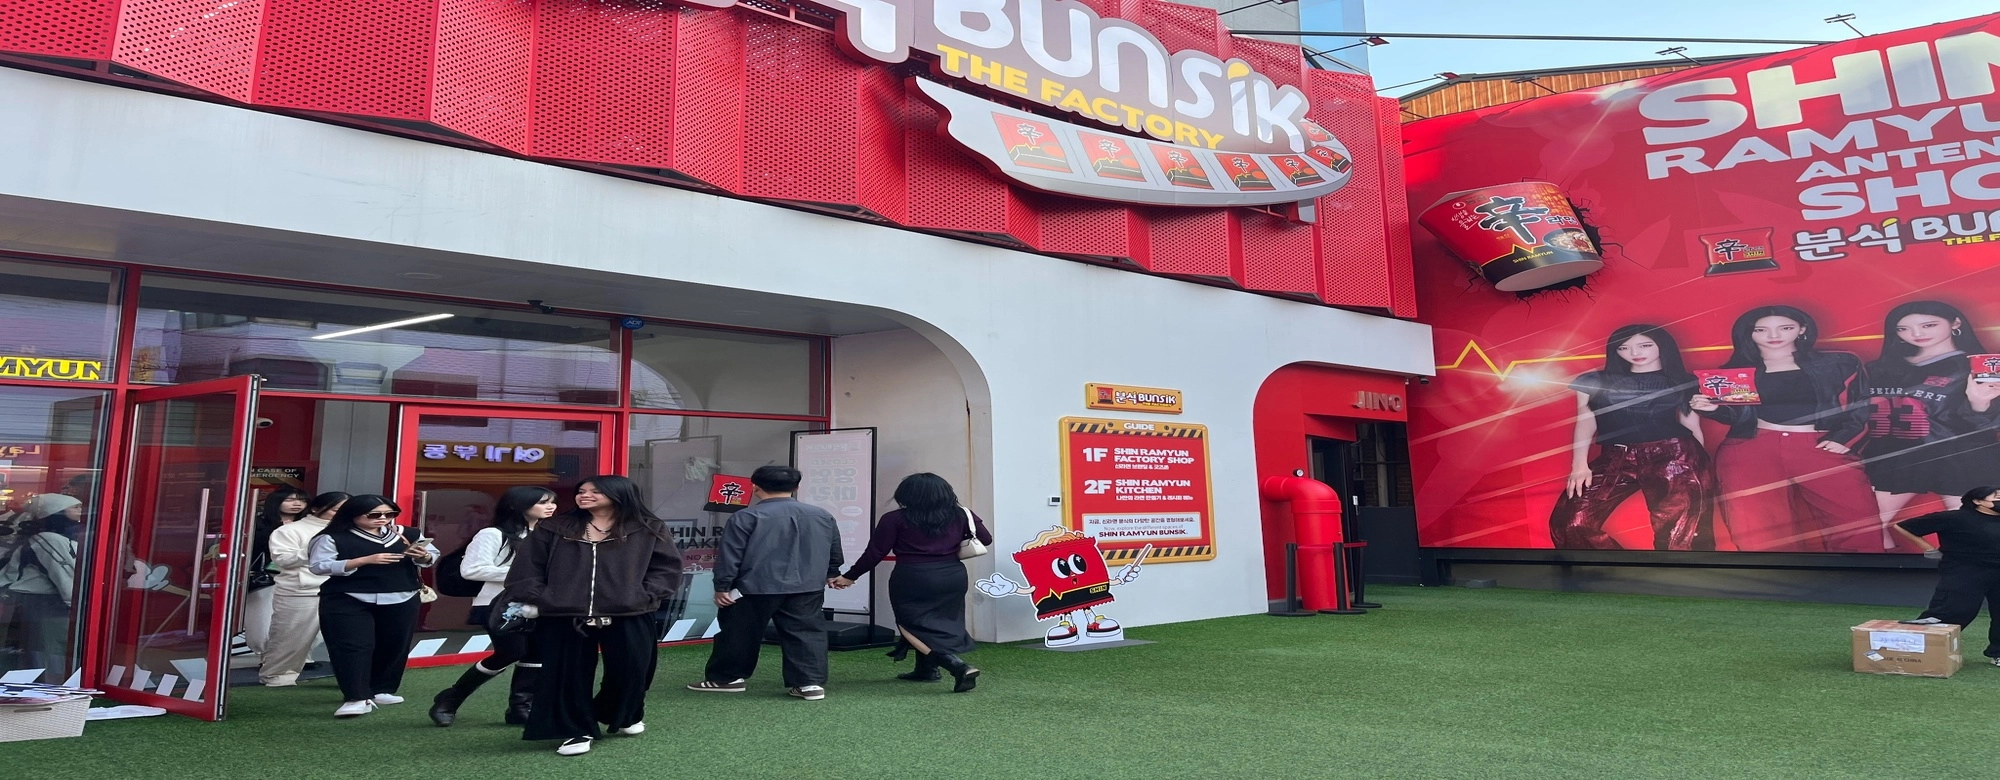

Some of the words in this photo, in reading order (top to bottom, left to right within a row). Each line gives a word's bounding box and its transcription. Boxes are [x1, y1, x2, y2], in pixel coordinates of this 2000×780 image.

[937, 43, 1029, 94] THE
[1040, 77, 1225, 150] FACTORY
[1796, 137, 2000, 183] ANTEN
[1798, 163, 2000, 221] SHO
[1473, 196, 1550, 244] 辛
[1795, 218, 1902, 261] 분식
[1942, 233, 1984, 246] THE
[1512, 255, 1527, 264] SHIN
[1527, 251, 1554, 260] RAMYUN
[1713, 238, 1748, 261] 辛
[1703, 375, 1735, 396] 辛
[1115, 391, 1137, 405] 분식
[1123, 423, 1154, 431] GUIDE
[1083, 448, 1108, 462] 1F
[1114, 448, 1138, 456] SHIN
[1140, 449, 1189, 457] RAMYUN
[1114, 455, 1165, 463] FACTORY
[719, 482, 745, 505] 辛
[1084, 480, 1112, 494] 2F
[1090, 584, 1107, 594] SHIN
